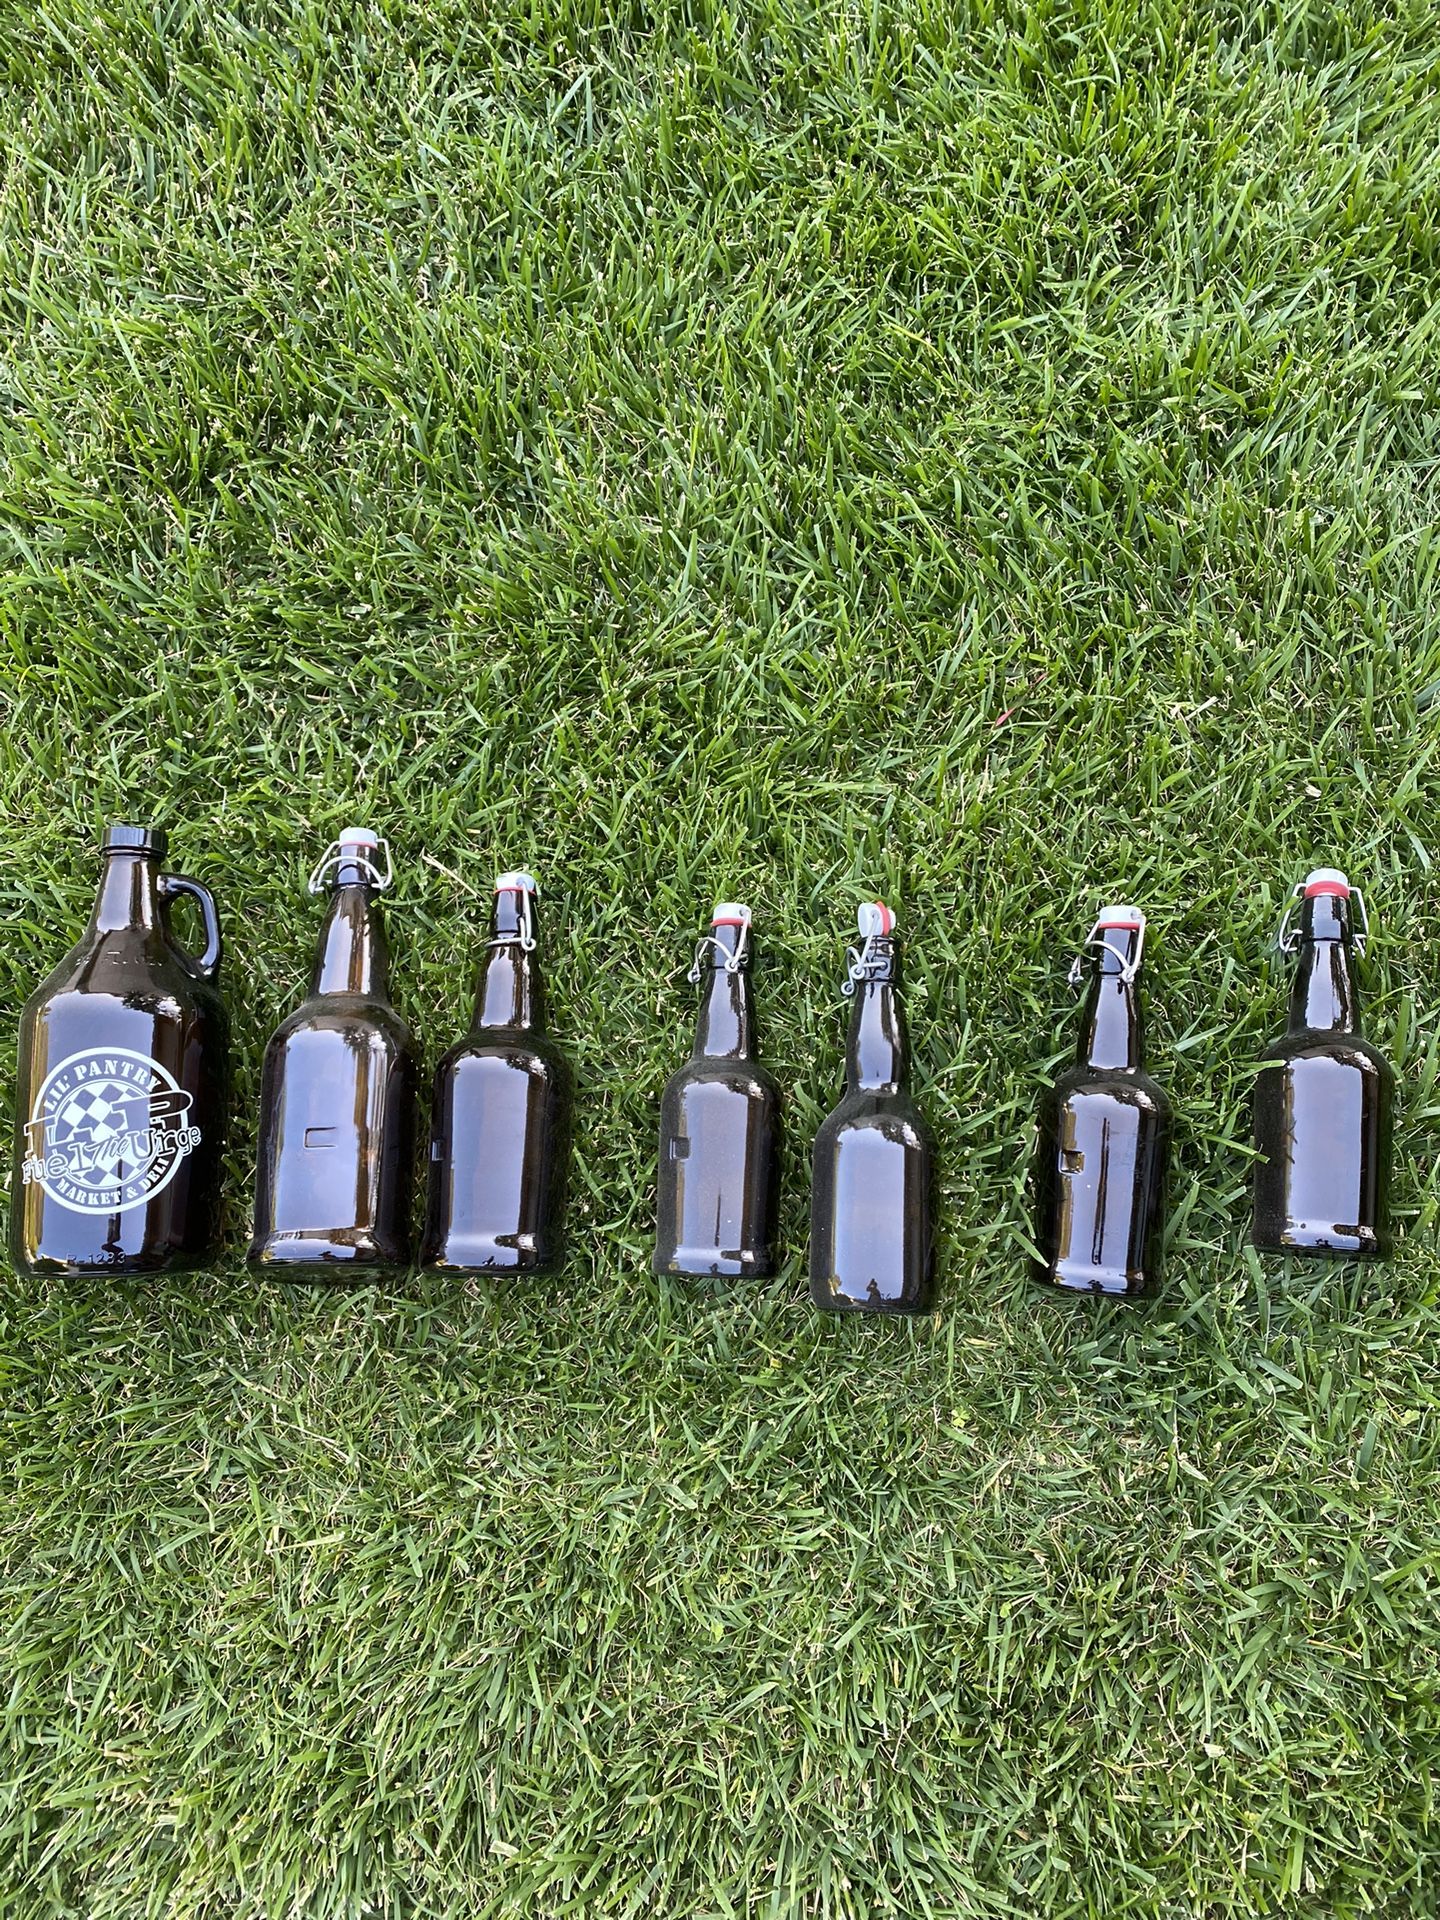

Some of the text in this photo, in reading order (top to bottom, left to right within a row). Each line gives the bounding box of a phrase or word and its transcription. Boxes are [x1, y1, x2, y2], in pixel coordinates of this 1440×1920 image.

[74, 1059, 162, 1092] PANTRY
[22, 1143, 95, 1184] Fuel
[128, 1126, 201, 1161] Urge
[56, 1157, 169, 1206] MARKET & DELI
